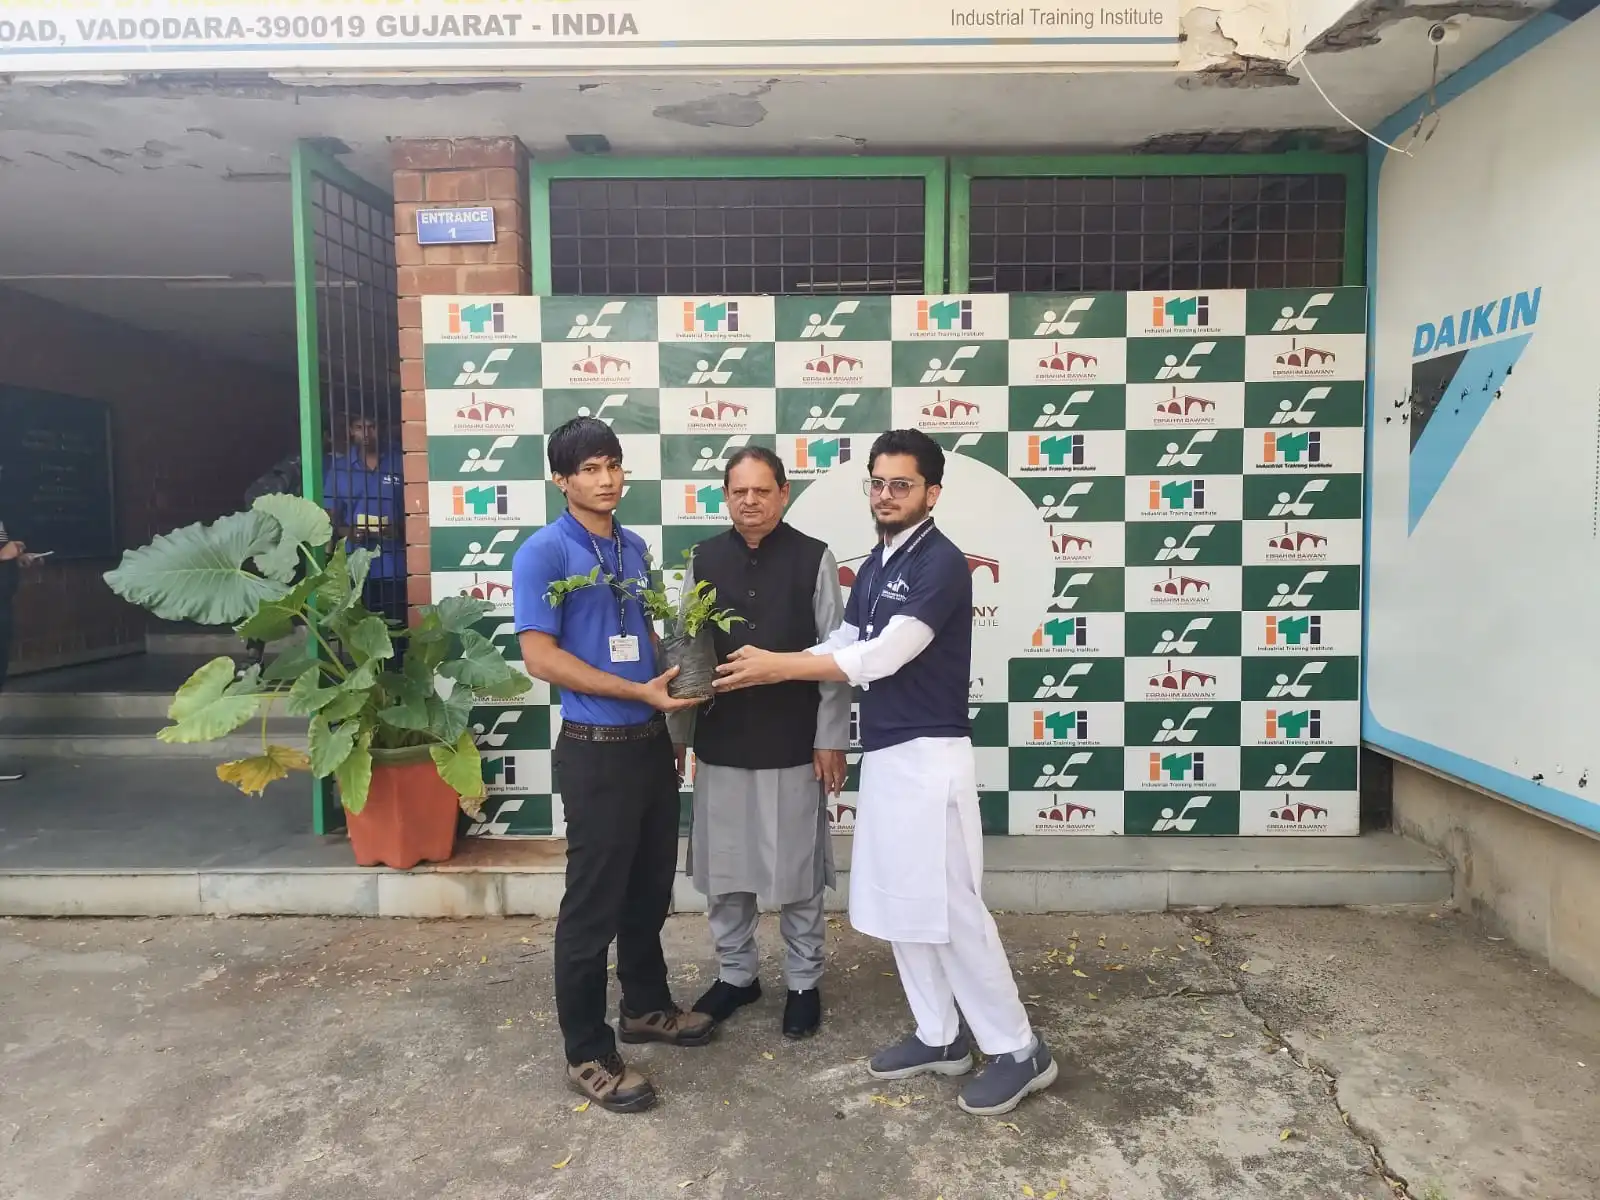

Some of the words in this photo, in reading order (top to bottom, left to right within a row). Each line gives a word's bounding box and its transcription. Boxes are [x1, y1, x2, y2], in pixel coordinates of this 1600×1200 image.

[76, 15, 365, 42] VADODARA-390019
[376, 13, 523, 38] GUJARAT
[552, 12, 639, 36] INDIA
[951, 8, 1024, 26] Industrial
[1029, 8, 1095, 30] Training
[1100, 7, 1163, 26] Institute
[421, 210, 489, 224] ENTRANCE
[447, 227, 456, 239] 1
[1412, 286, 1542, 358] DAIKIN
